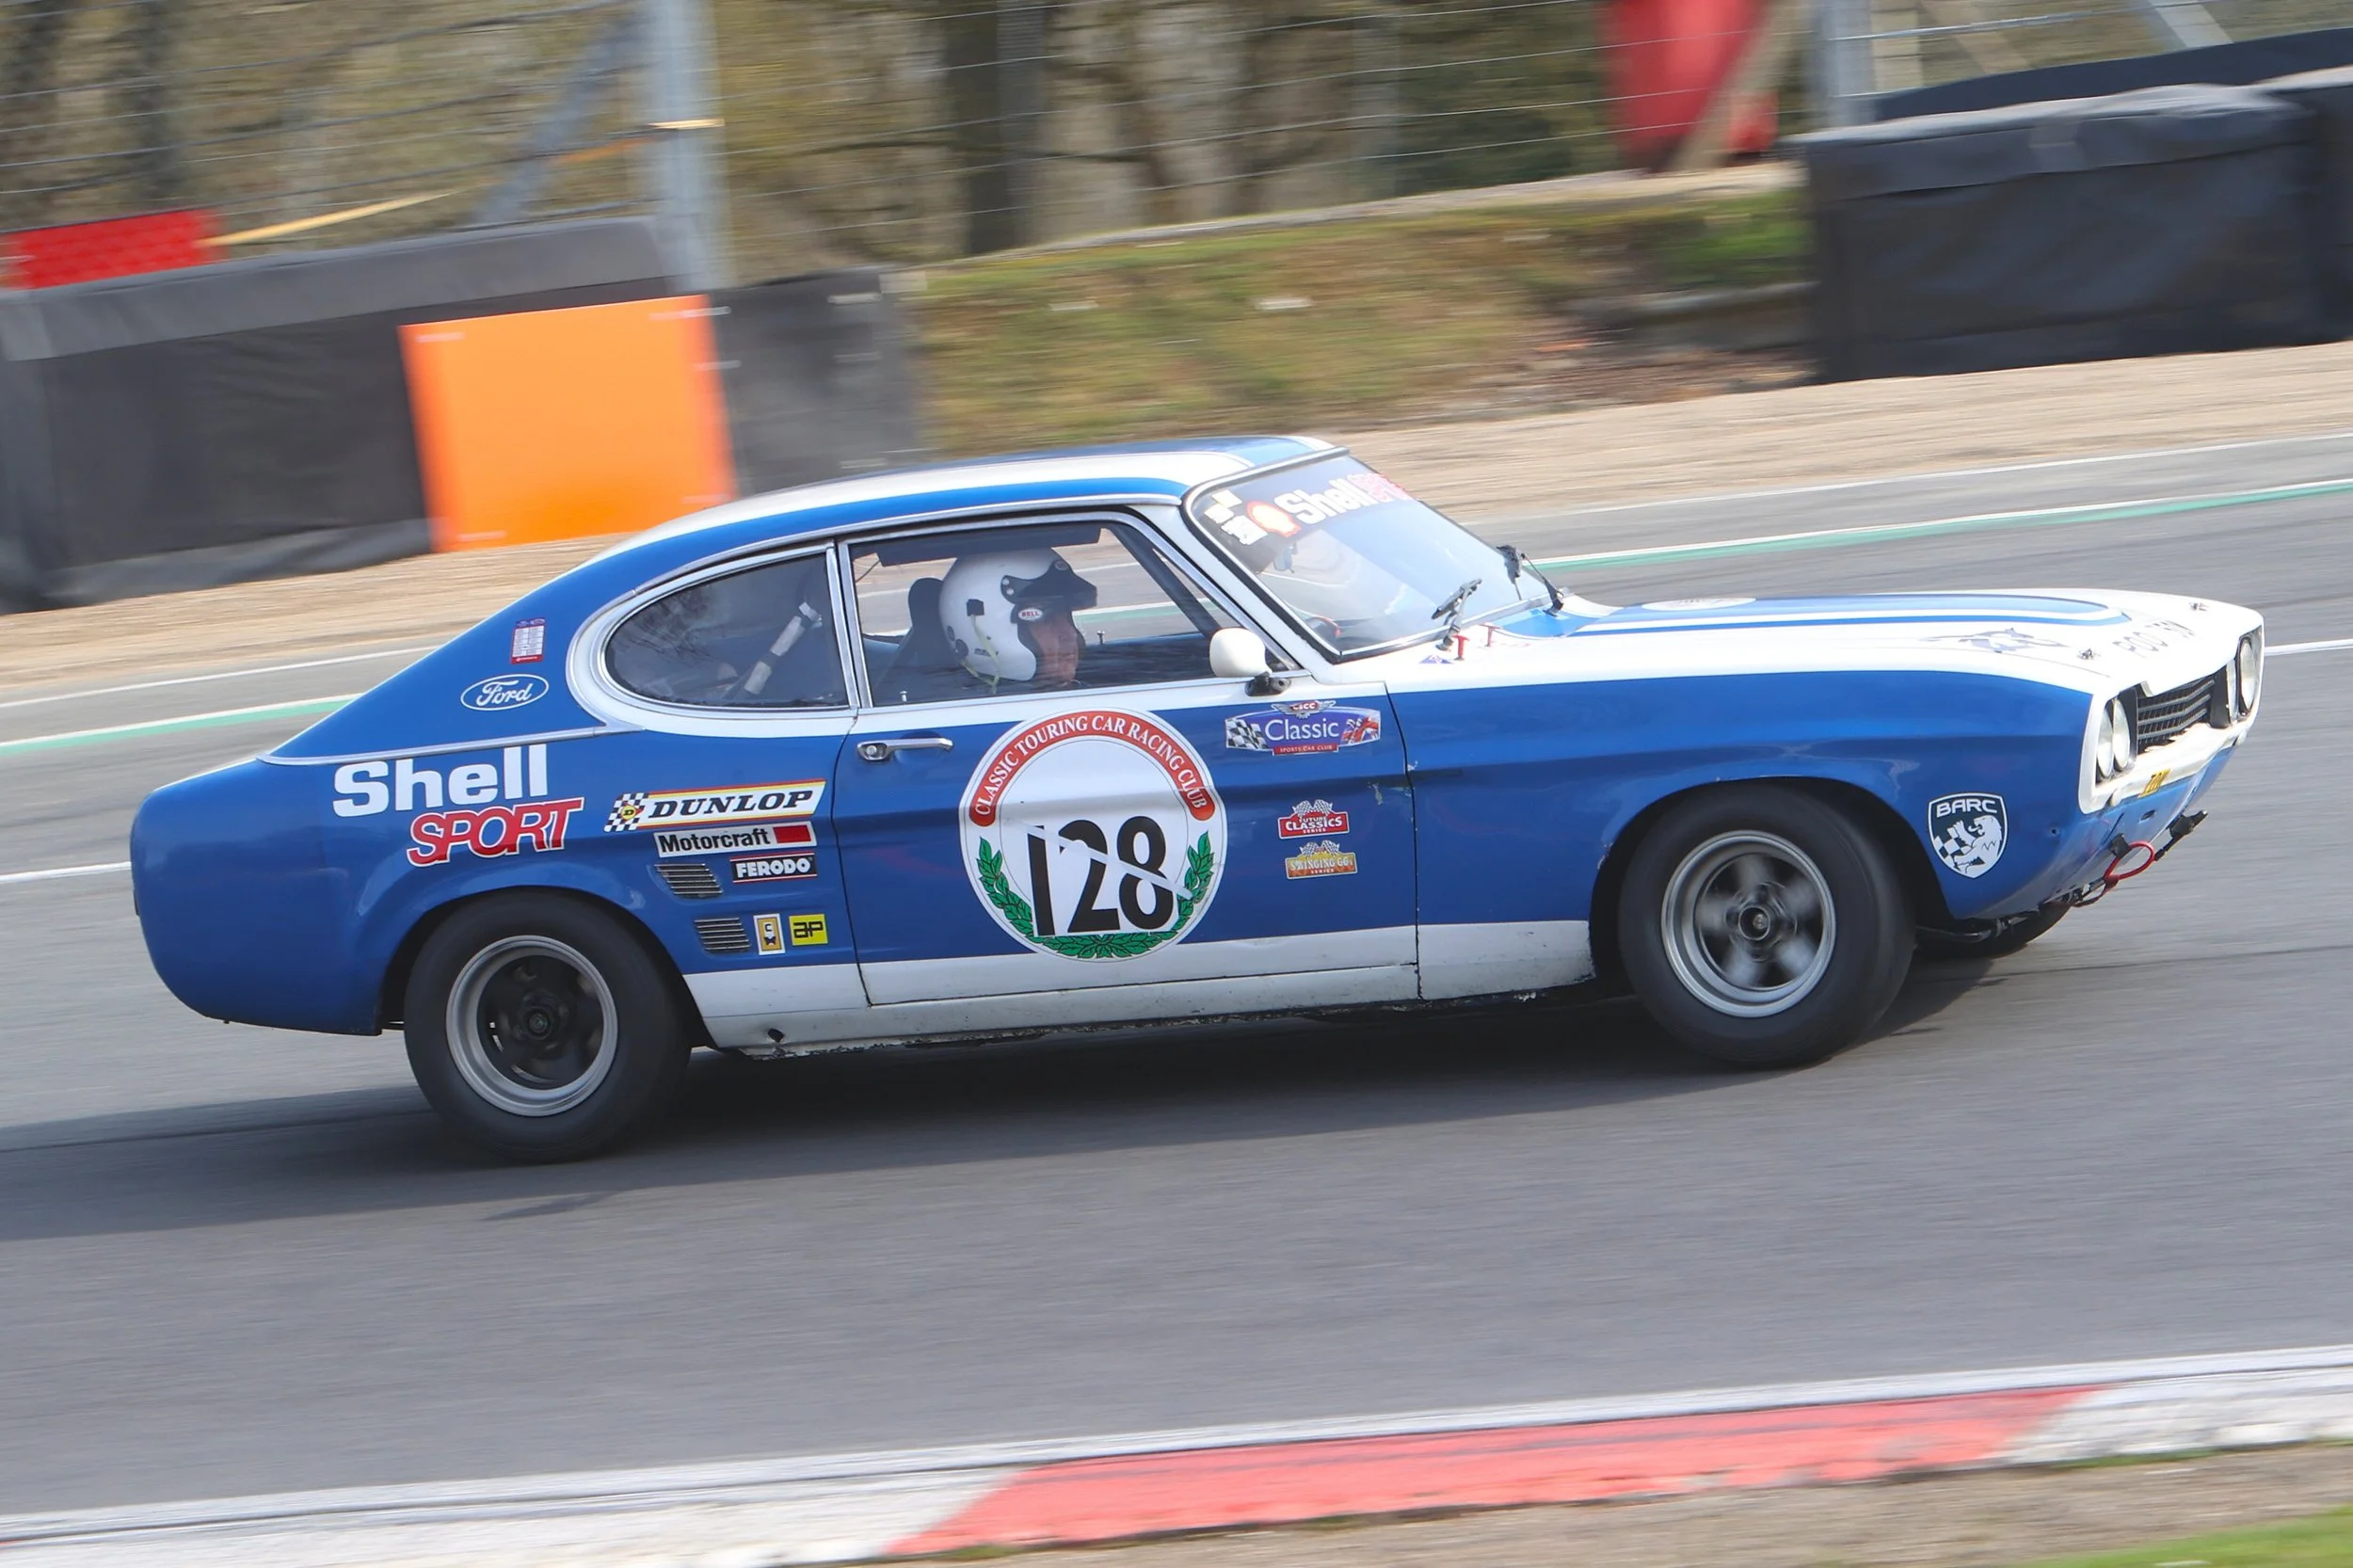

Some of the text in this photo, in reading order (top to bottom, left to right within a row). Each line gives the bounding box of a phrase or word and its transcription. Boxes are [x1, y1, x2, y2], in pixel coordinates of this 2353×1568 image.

[1274, 477, 1378, 524] Shell
[476, 680, 534, 707] Ford
[1265, 718, 1339, 741] Classic
[975, 714, 1208, 815] CLASSIC TOURING CAR RACING CLUB
[332, 744, 548, 817] Shell
[648, 790, 813, 819] DUNLOP
[1937, 798, 1997, 818] BARC
[407, 797, 584, 867] SPORT
[1285, 816, 1343, 831] CLASSICS
[658, 828, 771, 853] Motorcraft
[735, 858, 811, 878] FERODO
[1027, 816, 1174, 936] 128
